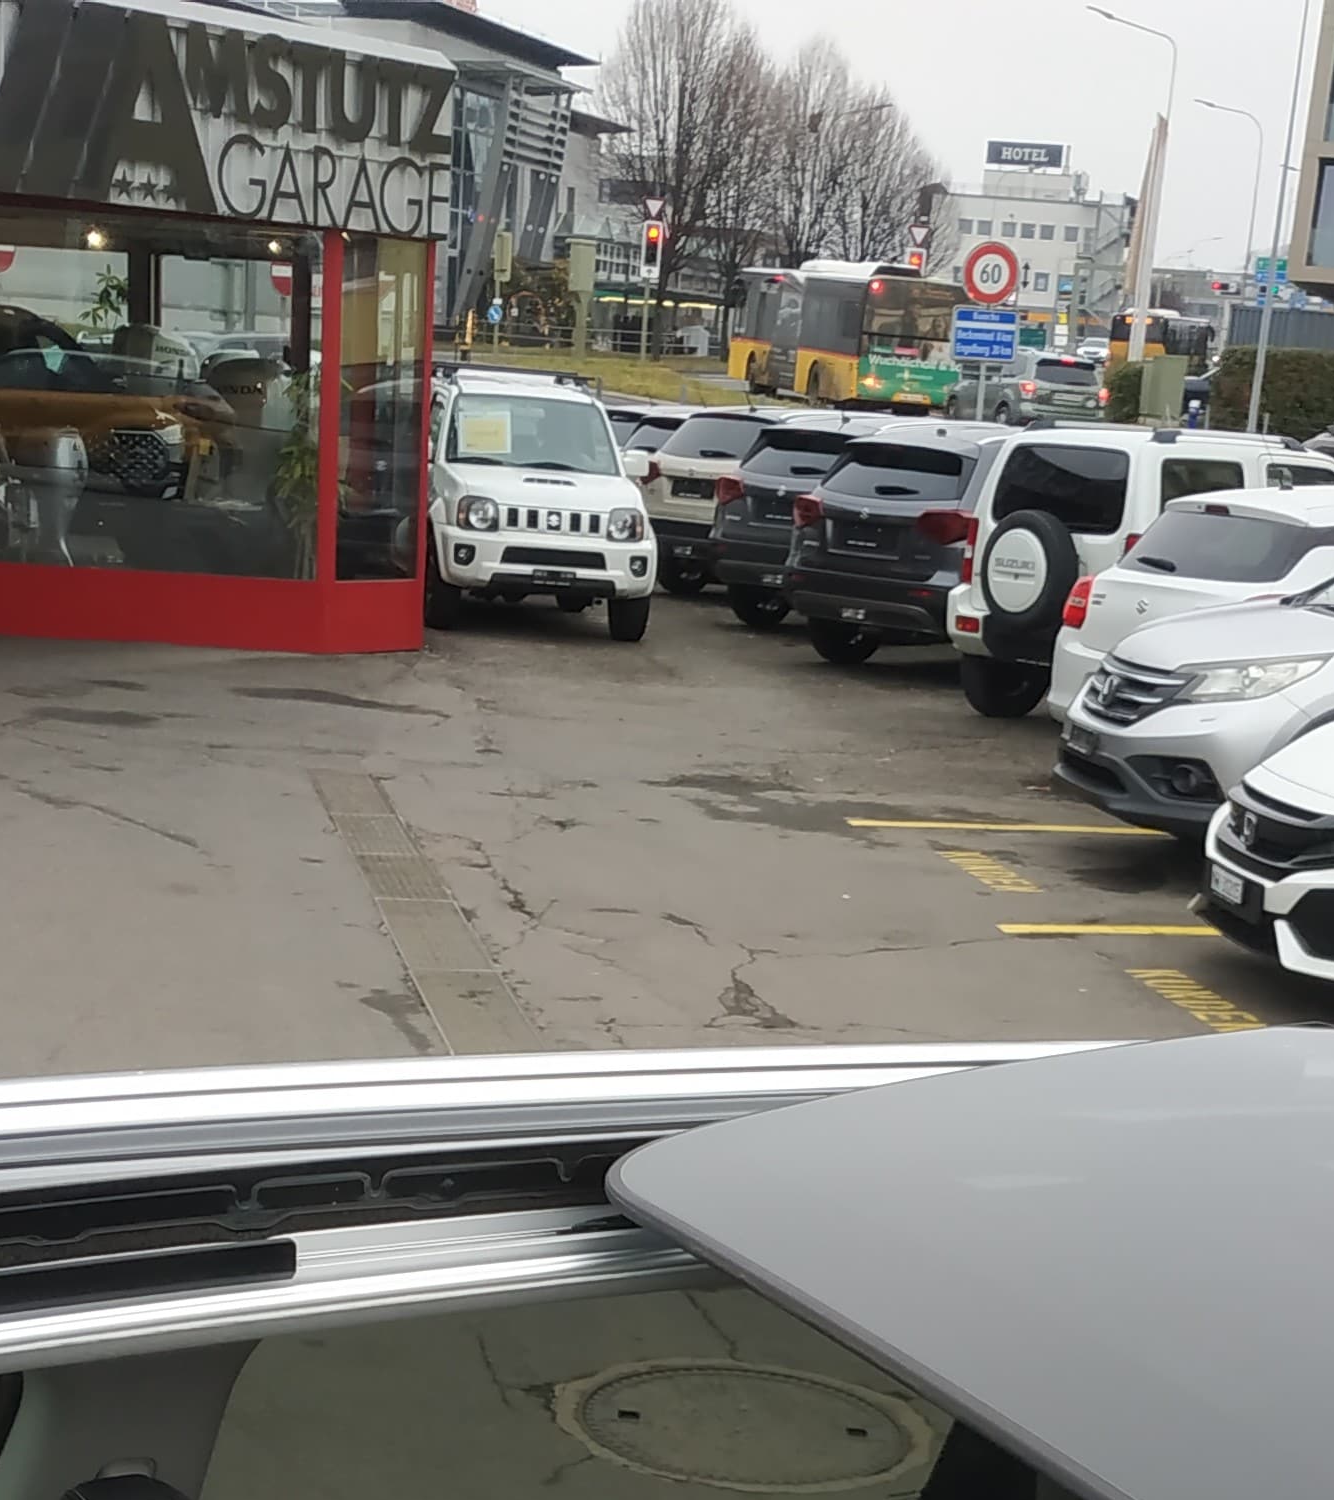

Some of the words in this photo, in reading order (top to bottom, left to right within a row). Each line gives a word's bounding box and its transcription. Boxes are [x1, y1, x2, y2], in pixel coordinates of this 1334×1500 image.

[87, 8, 456, 215] AMSTUTZ
[1000, 146, 1050, 162] HOTEL
[218, 133, 451, 241] GARAGE
[980, 263, 1003, 285] 60
[994, 556, 1036, 571] SUZUKI
[1123, 969, 1267, 1033] KUNDEN
